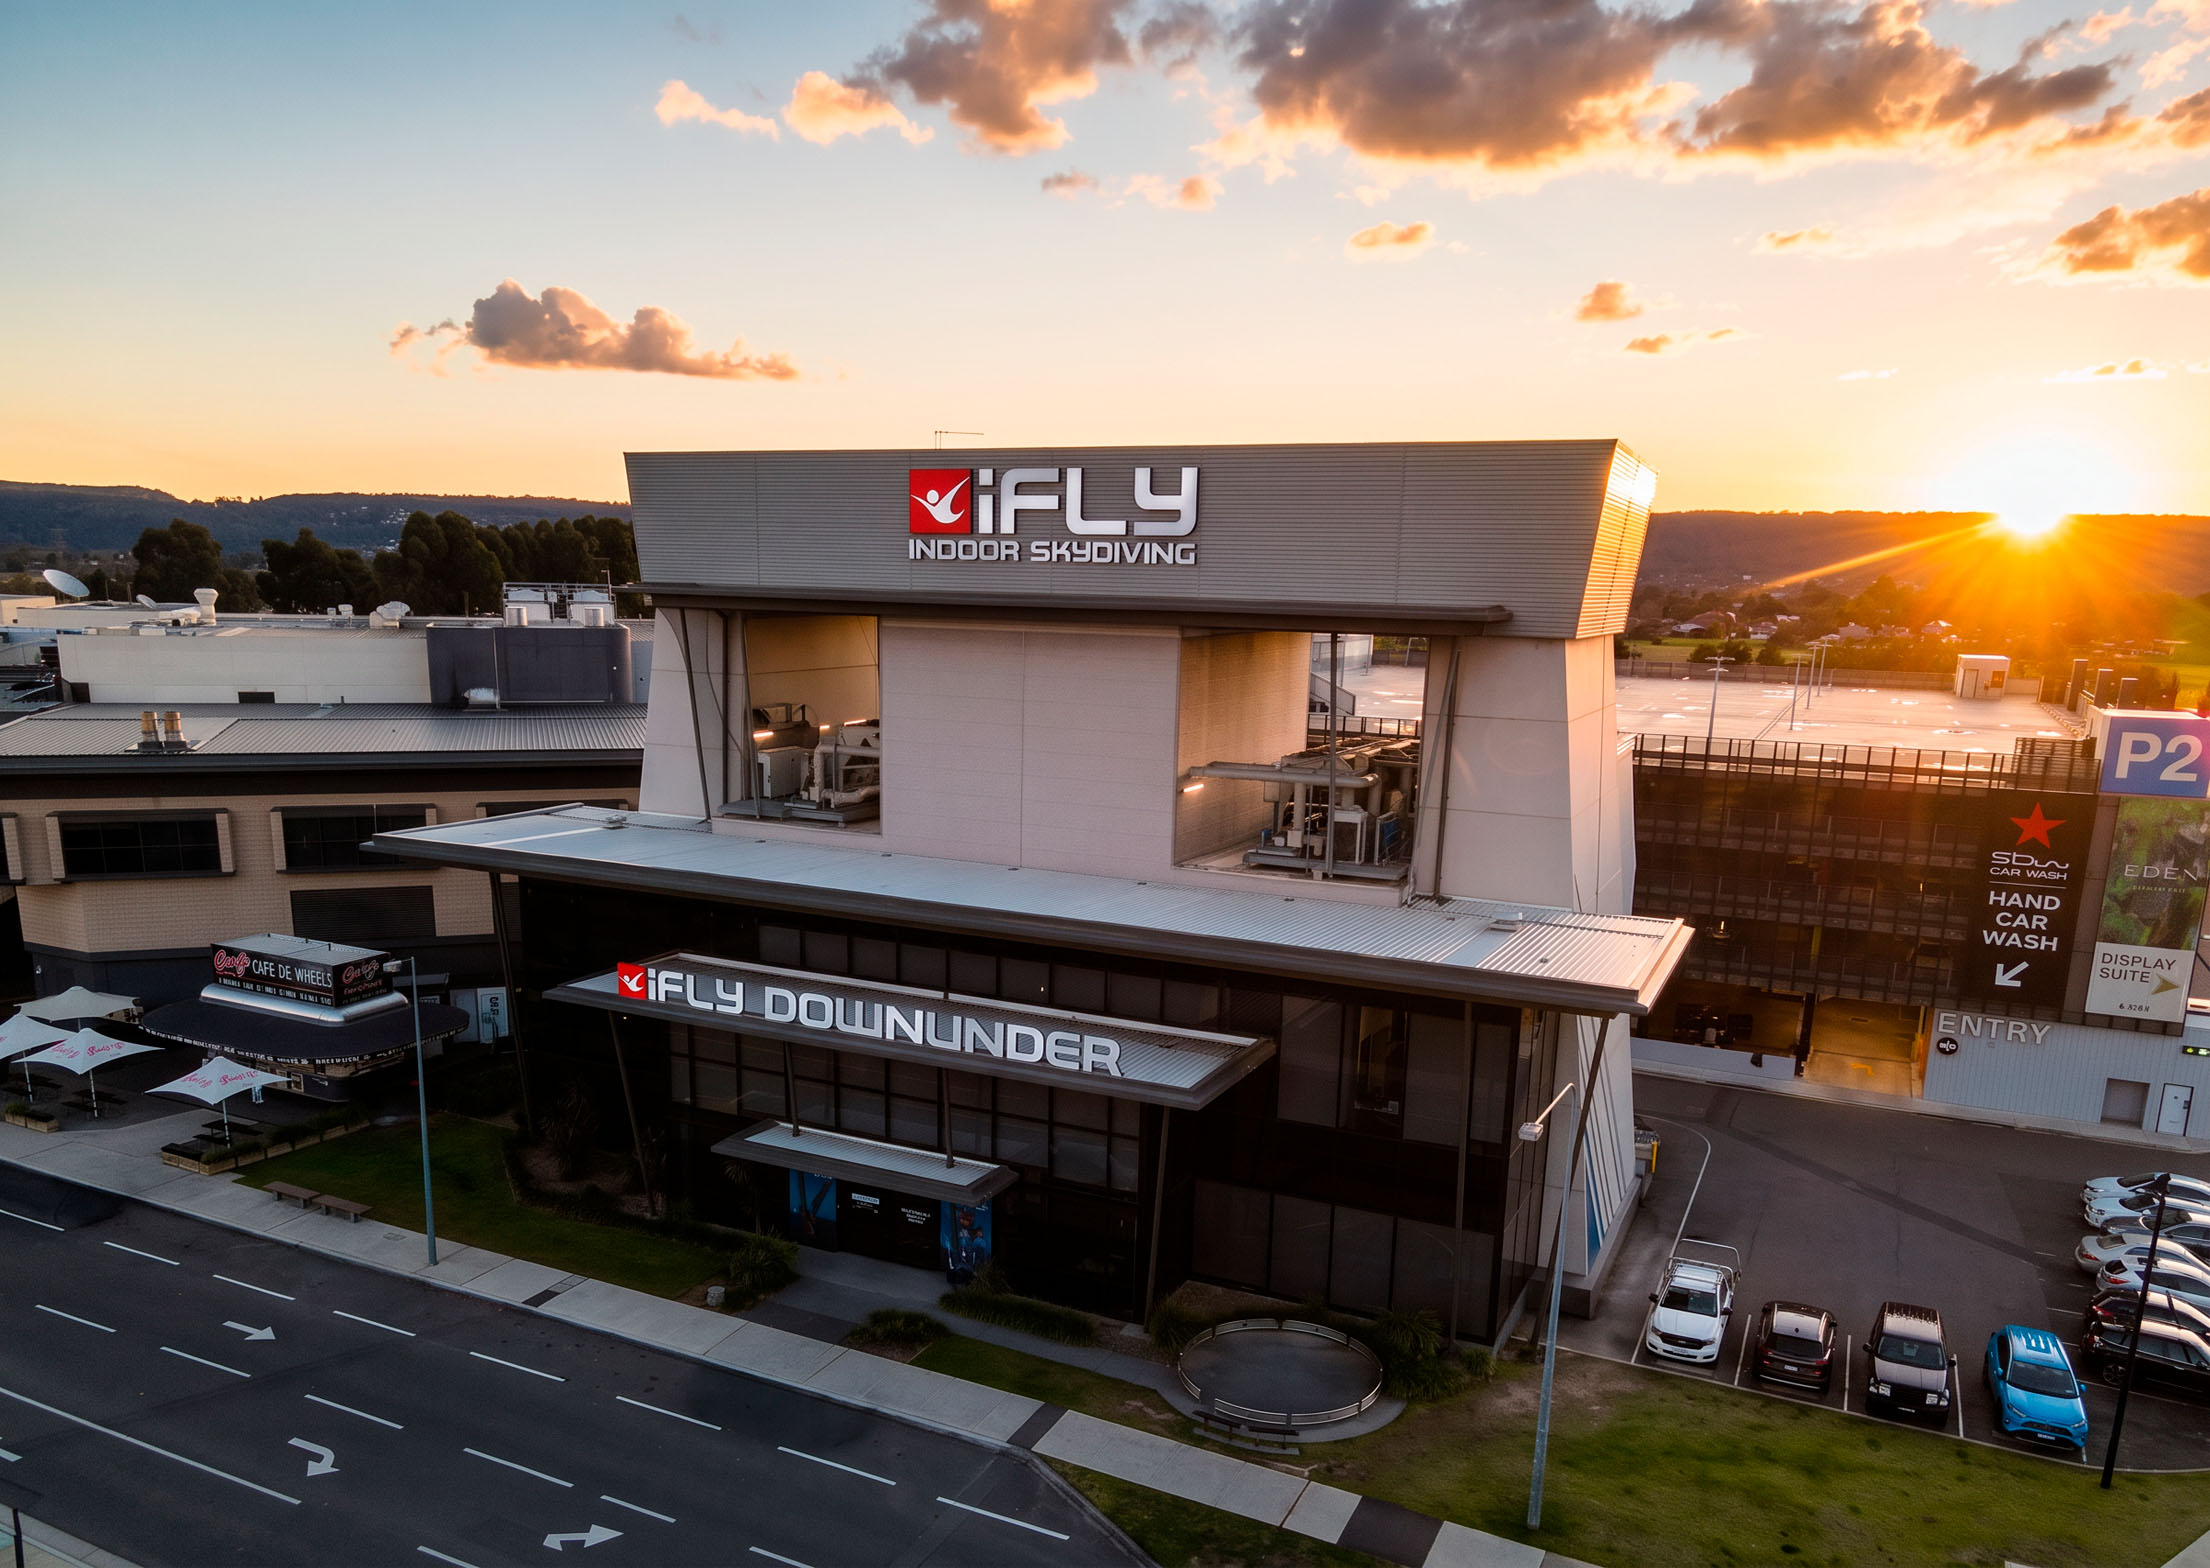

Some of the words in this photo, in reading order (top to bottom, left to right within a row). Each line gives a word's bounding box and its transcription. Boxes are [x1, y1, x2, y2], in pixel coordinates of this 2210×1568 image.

[979, 467, 1198, 536] iFLY
[909, 539, 1020, 561] INDOOR
[1030, 541, 1197, 564] SKYDIVING
[2114, 731, 2203, 782] P2
[1989, 867, 2021, 877] CAR
[2026, 869, 2067, 880] WASH
[2124, 864, 2200, 881] EDEN
[1988, 890, 2061, 911] HAND
[1995, 912, 2048, 931] CAR
[1982, 930, 2058, 952] WASH
[2101, 952, 2176, 971] DISPLAY
[252, 959, 275, 978] CAFE
[278, 965, 293, 981] DE
[295, 970, 333, 988] WHEELS
[2099, 967, 2151, 983] SUITE
[647, 968, 744, 1016] iFLY
[765, 986, 1124, 1077] DOWNUNDER
[1938, 1012, 2051, 1044] ENTRY
